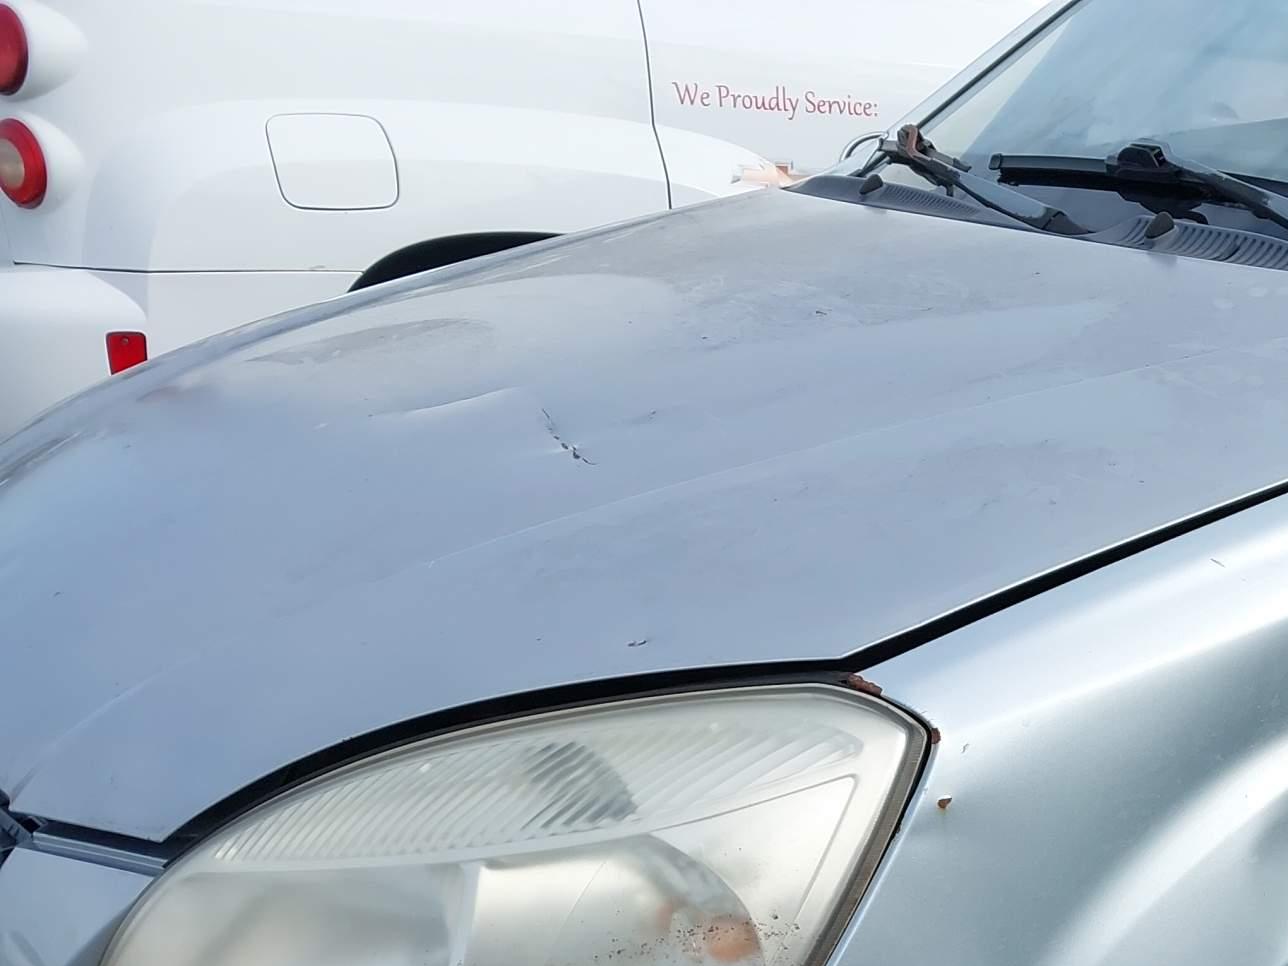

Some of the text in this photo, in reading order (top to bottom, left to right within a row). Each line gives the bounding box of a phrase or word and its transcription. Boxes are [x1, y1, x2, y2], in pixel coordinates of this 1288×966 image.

[672, 81, 879, 120] We Proudly Service:
